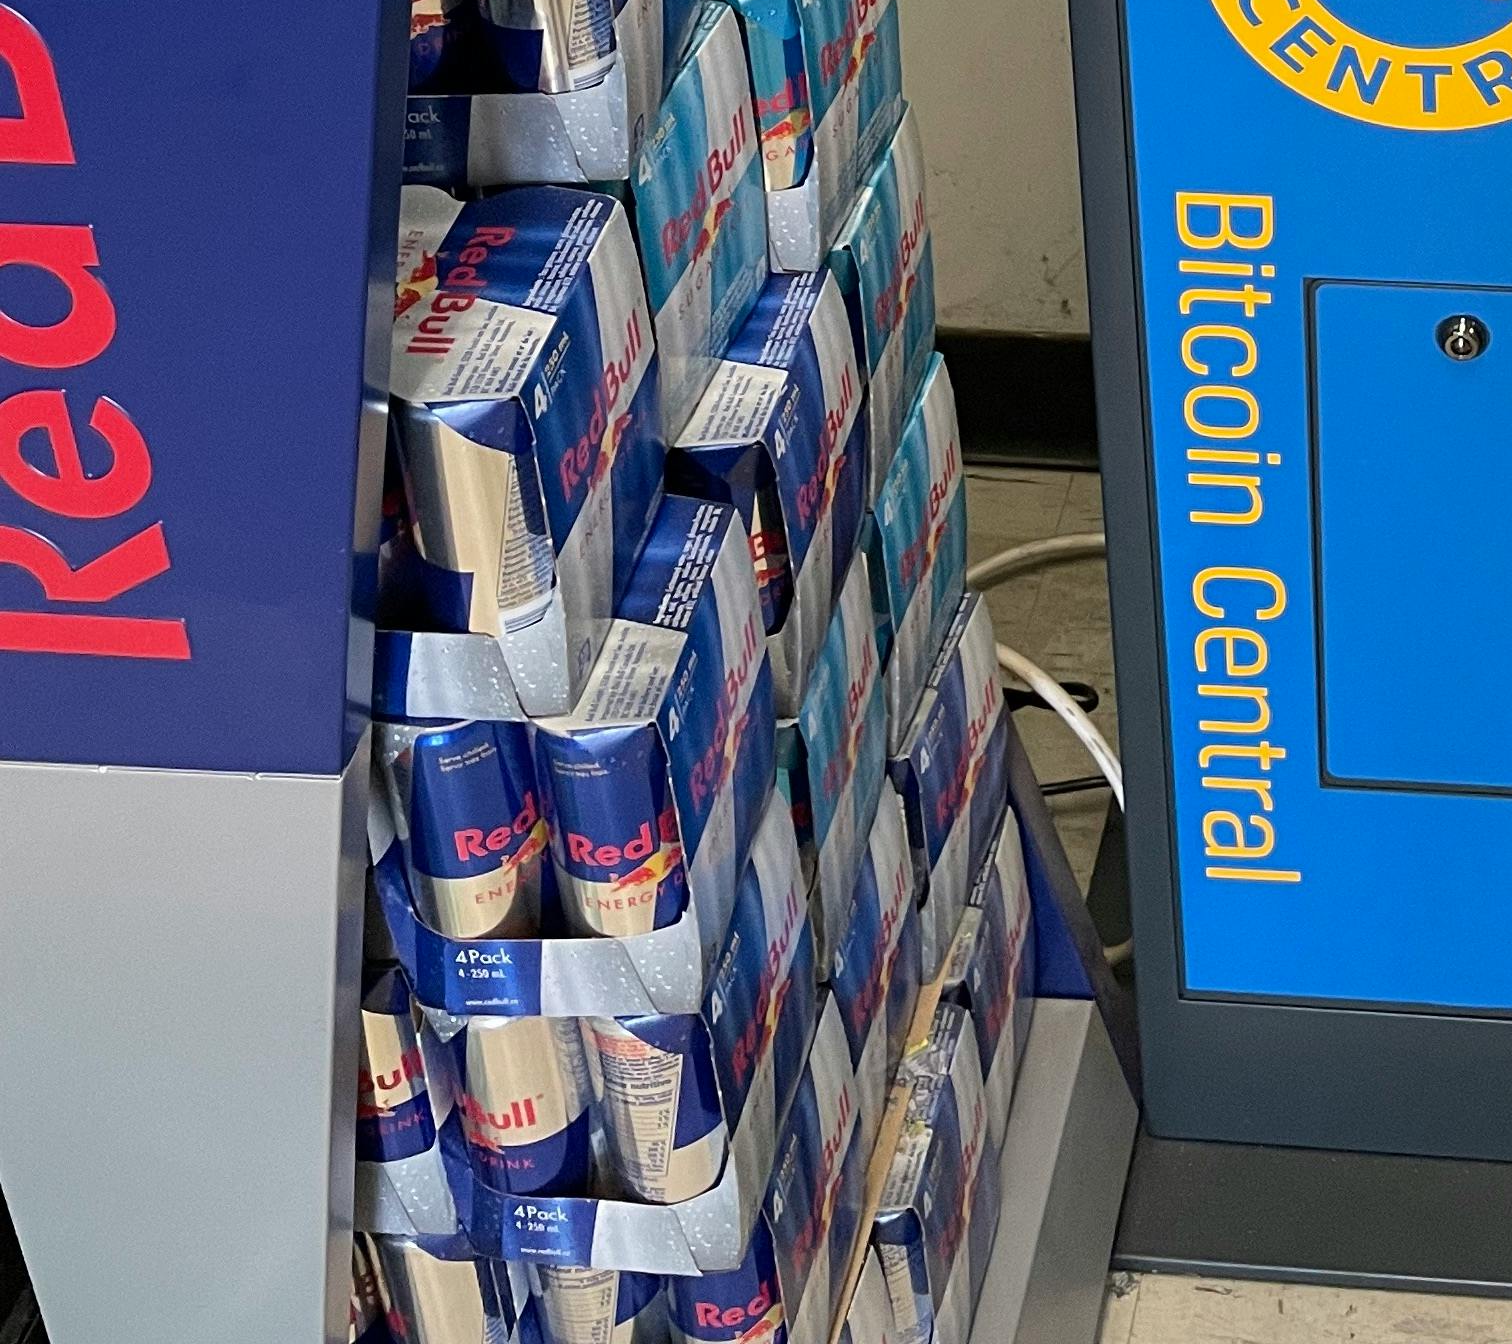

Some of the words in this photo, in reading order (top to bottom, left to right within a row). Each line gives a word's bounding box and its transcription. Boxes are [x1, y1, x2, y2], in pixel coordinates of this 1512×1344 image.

[707, 107, 747, 191] Bull
[444, 226, 516, 289] Red
[405, 292, 476, 357] Bull
[1175, 191, 1281, 526] Bitcoin
[559, 397, 605, 502] Red
[602, 308, 642, 403] Bull
[1192, 565, 1302, 882] Central
[454, 791, 539, 862] Red
[568, 822, 654, 867] Red
[694, 1280, 772, 1327] Red
